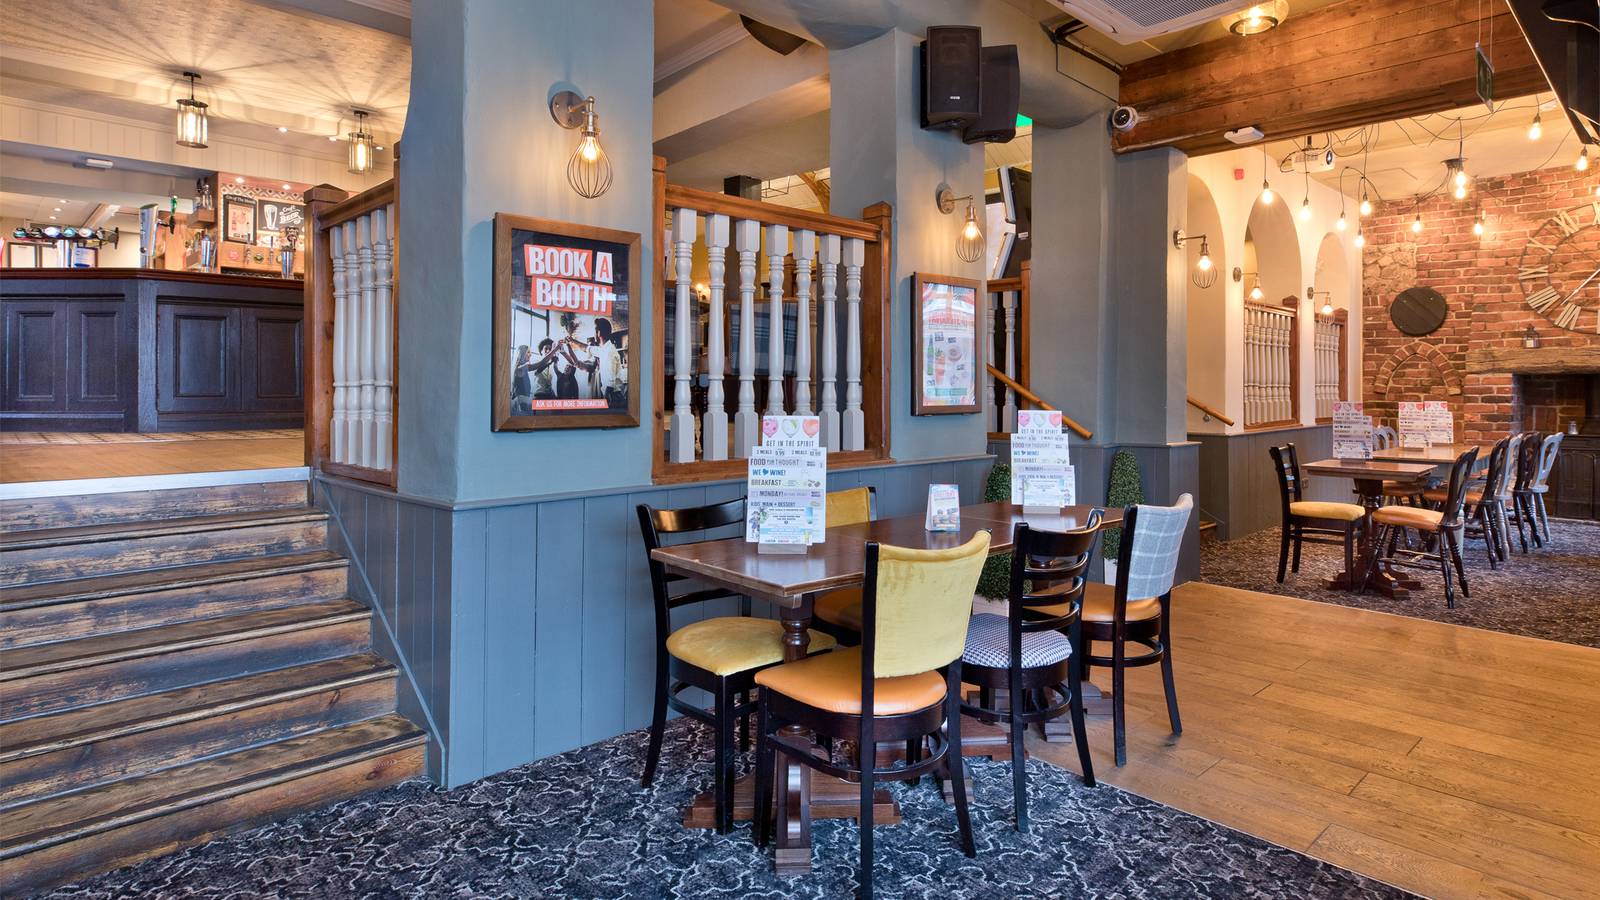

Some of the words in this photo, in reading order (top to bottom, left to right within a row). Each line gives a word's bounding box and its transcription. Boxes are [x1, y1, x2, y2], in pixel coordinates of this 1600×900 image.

[528, 246, 589, 278] BOOK
[599, 255, 610, 279] A
[536, 278, 607, 312] BOOTH
